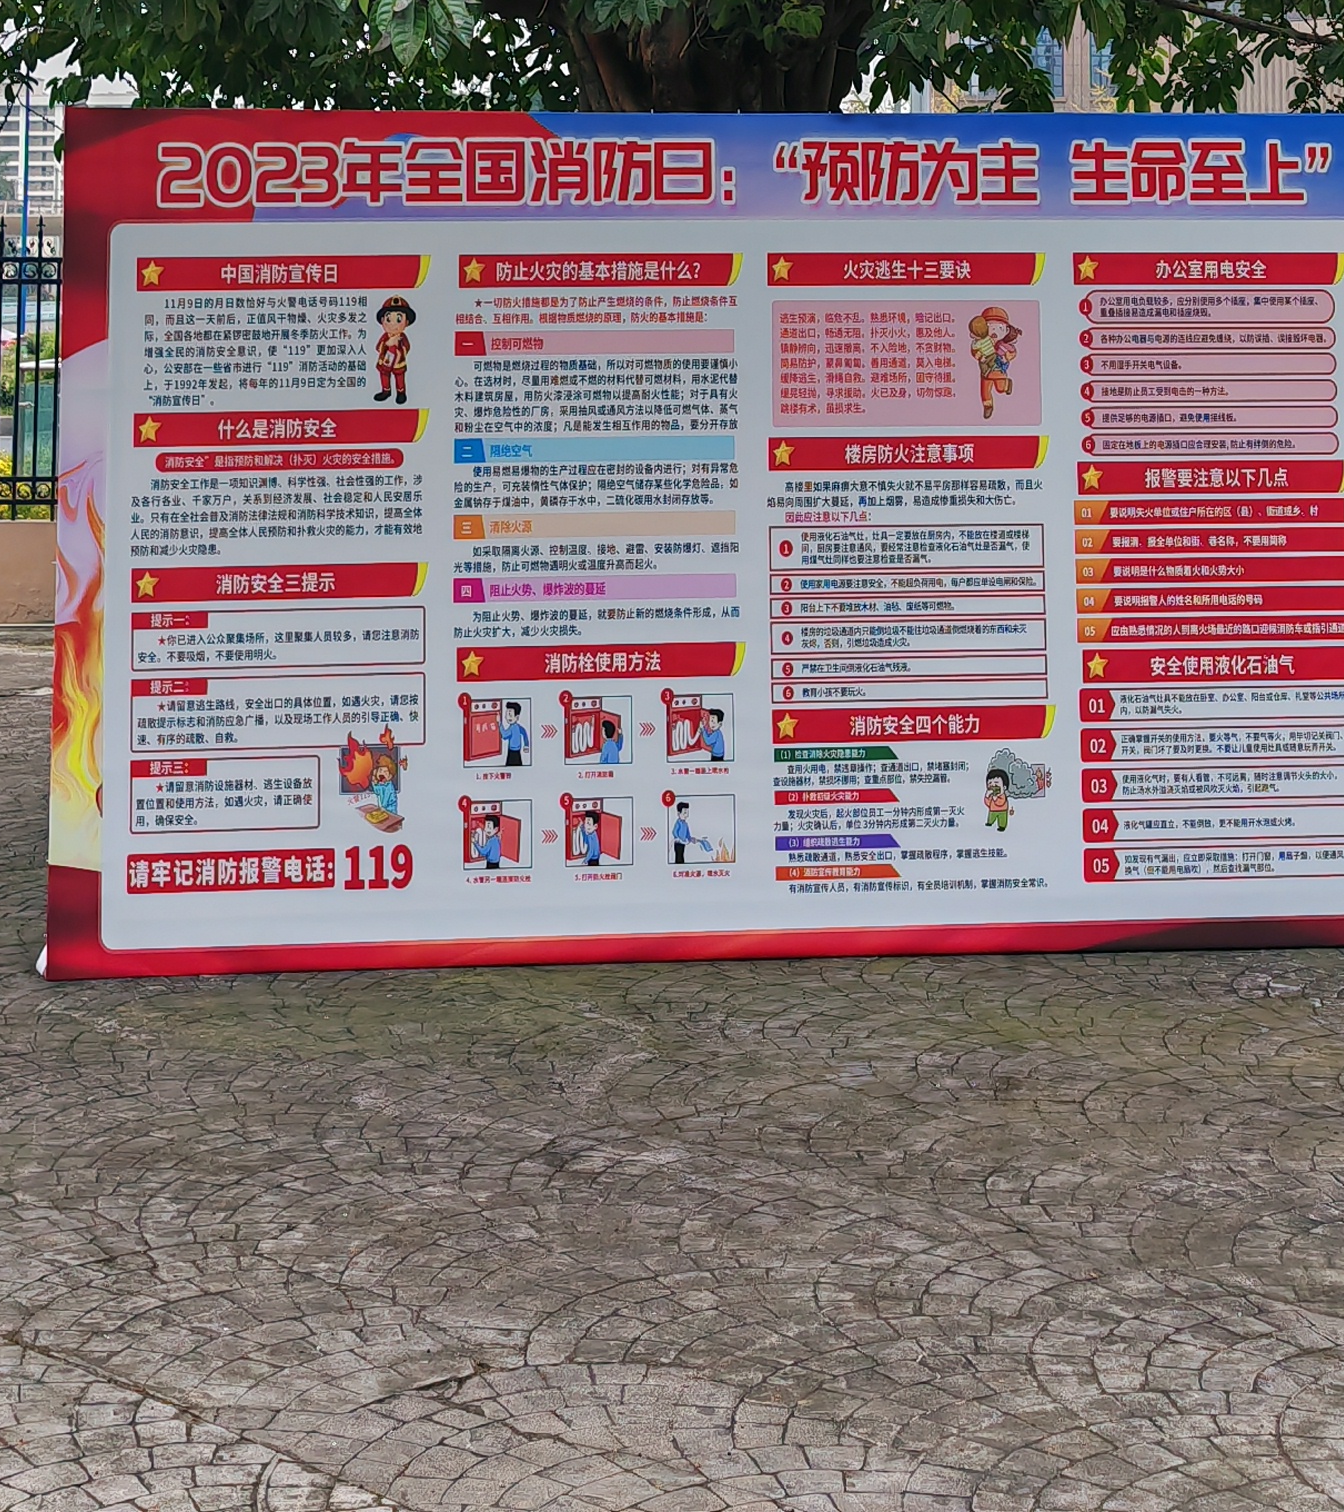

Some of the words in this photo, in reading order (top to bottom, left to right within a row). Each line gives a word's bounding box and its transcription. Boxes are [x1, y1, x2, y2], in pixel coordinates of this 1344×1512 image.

[221, 264, 338, 284] 中国消防宣传日
[844, 260, 971, 280] 火灾逃生十三要诀
[1156, 260, 1267, 279] 办公室用电安全
[491, 337, 544, 351] 控制可燃物
[218, 418, 337, 440] 什么是消防安全
[845, 444, 974, 464] 楼房防火注意事项
[1145, 468, 1289, 488] 报警要注意以下几点
[1081, 508, 1092, 518] 01
[1082, 538, 1093, 547] 02
[131, 544, 221, 557] 预防和减少火灾隐患。
[1083, 567, 1094, 576] 03
[216, 572, 335, 594] 消防安全三提示
[462, 585, 471, 597] 四
[489, 582, 605, 597] 阻止火势、爆炸波的蔓延
[1084, 597, 1095, 607] 04
[1085, 627, 1096, 636] 05
[545, 652, 661, 673] 消防栓使用方法
[1150, 655, 1295, 676] 安全使用液化石油气
[803, 687, 866, 698] 教育小孩不要玩火。
[1089, 698, 1105, 713] 01
[850, 714, 980, 736] 消防安全四个能力
[1090, 738, 1106, 753] 02
[1091, 778, 1107, 793] 03
[136, 814, 198, 827] 用，确保安全。
[1092, 818, 1108, 833] 04
[344, 844, 414, 890] 119
[1093, 858, 1110, 873] 05
